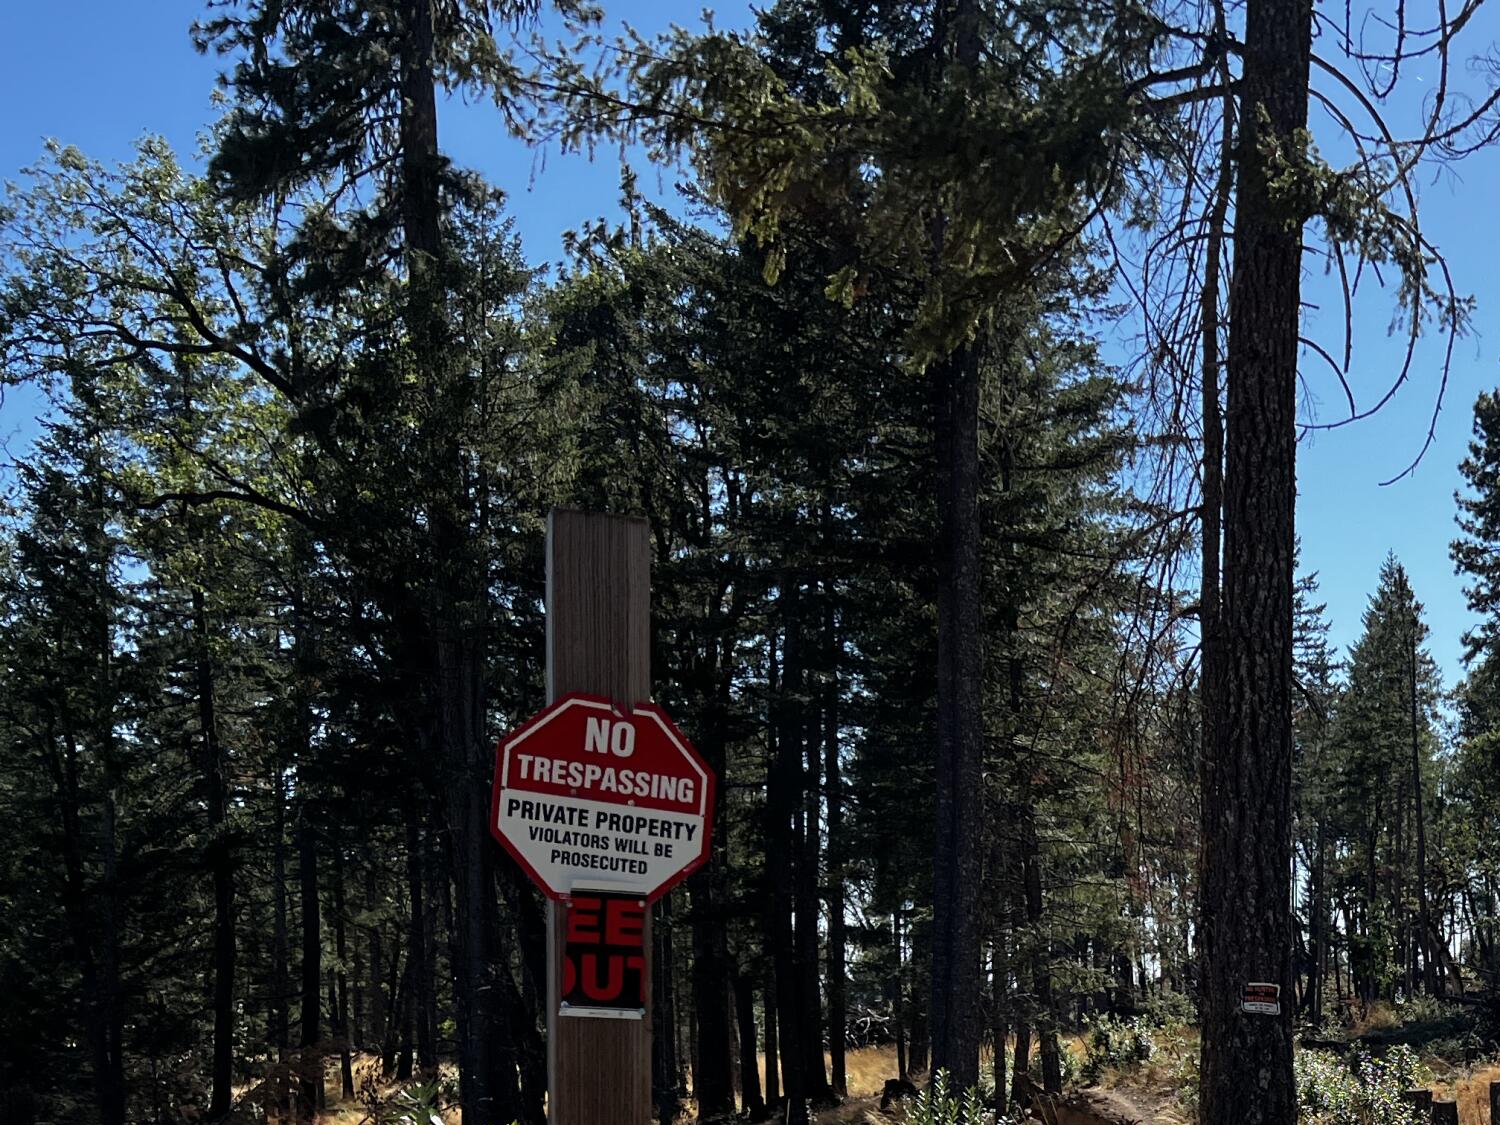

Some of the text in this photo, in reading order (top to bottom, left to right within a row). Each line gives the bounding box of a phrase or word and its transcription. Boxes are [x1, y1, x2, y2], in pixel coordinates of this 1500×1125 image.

[584, 716, 636, 758] NO
[517, 754, 694, 803] TRESPASSING
[507, 798, 697, 842] PRIVATE PROPERTY
[529, 825, 673, 858] VIOLATORS WILL BE
[550, 849, 648, 875] PROSECUTED
